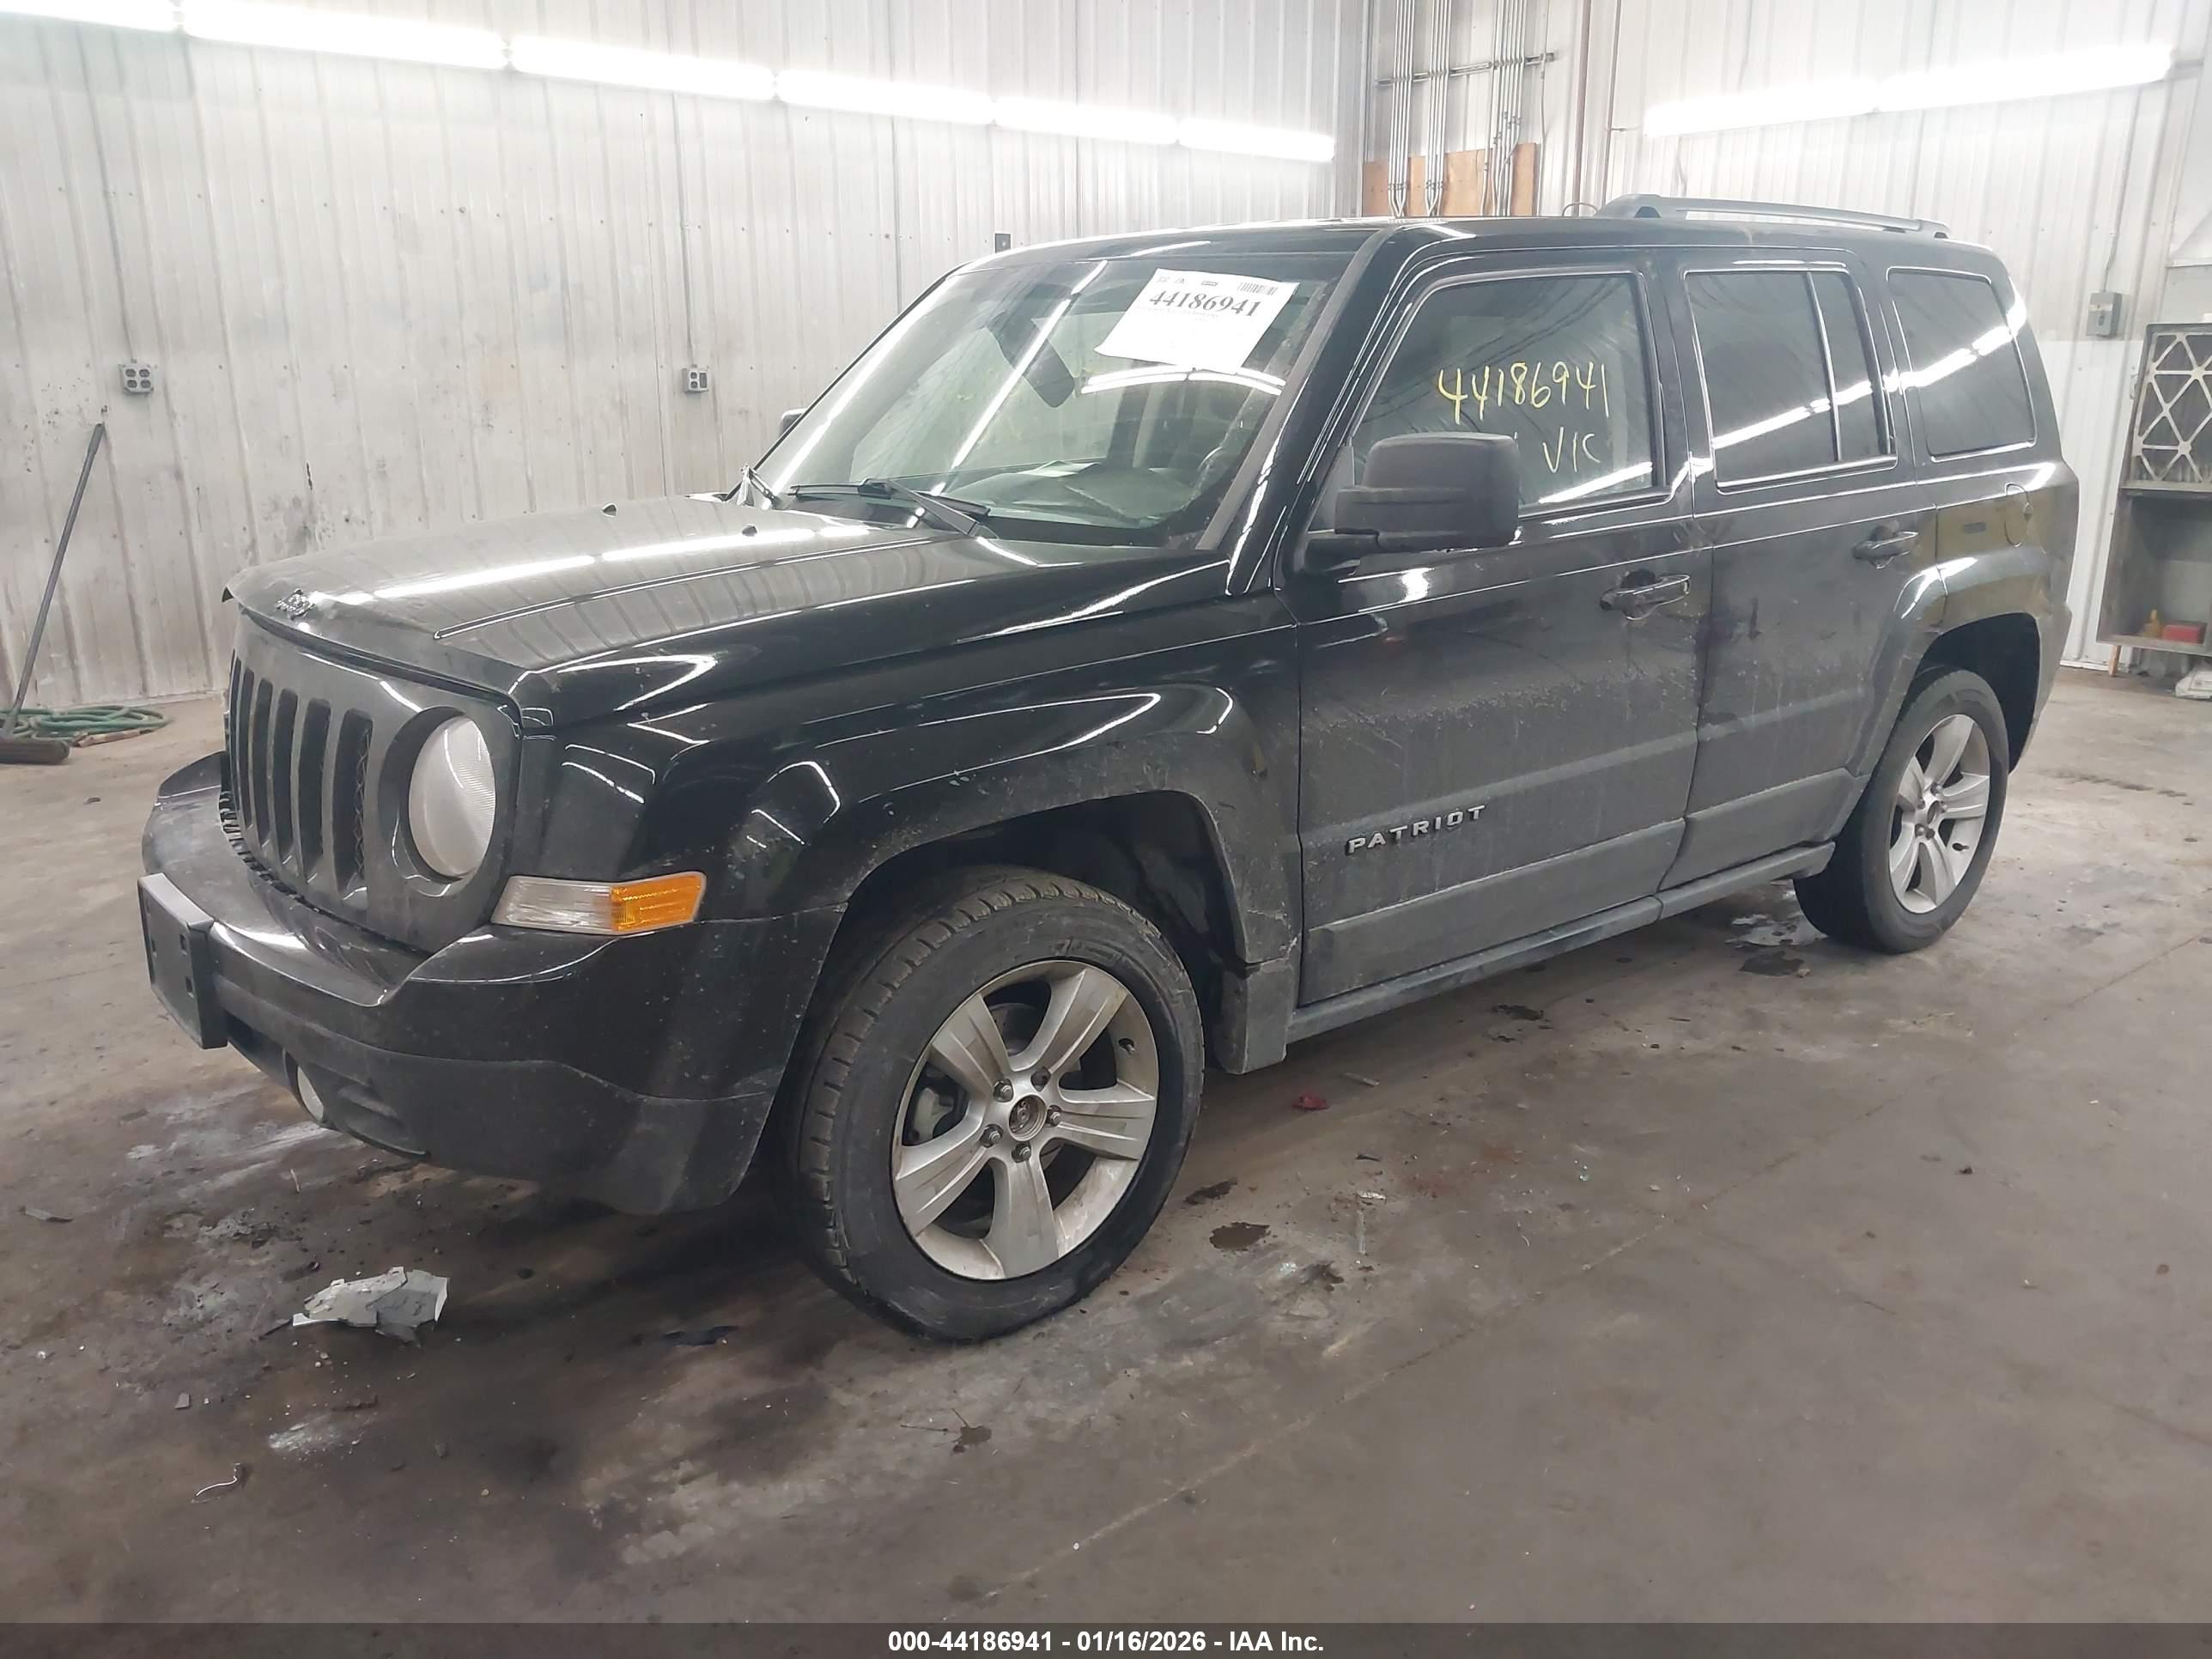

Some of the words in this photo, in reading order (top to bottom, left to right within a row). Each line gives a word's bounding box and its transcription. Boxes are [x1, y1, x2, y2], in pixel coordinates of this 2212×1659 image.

[1149, 290, 1261, 317] 44186941
[1437, 360, 1610, 426] 44186941
[1346, 804, 1487, 855] PATRIOT
